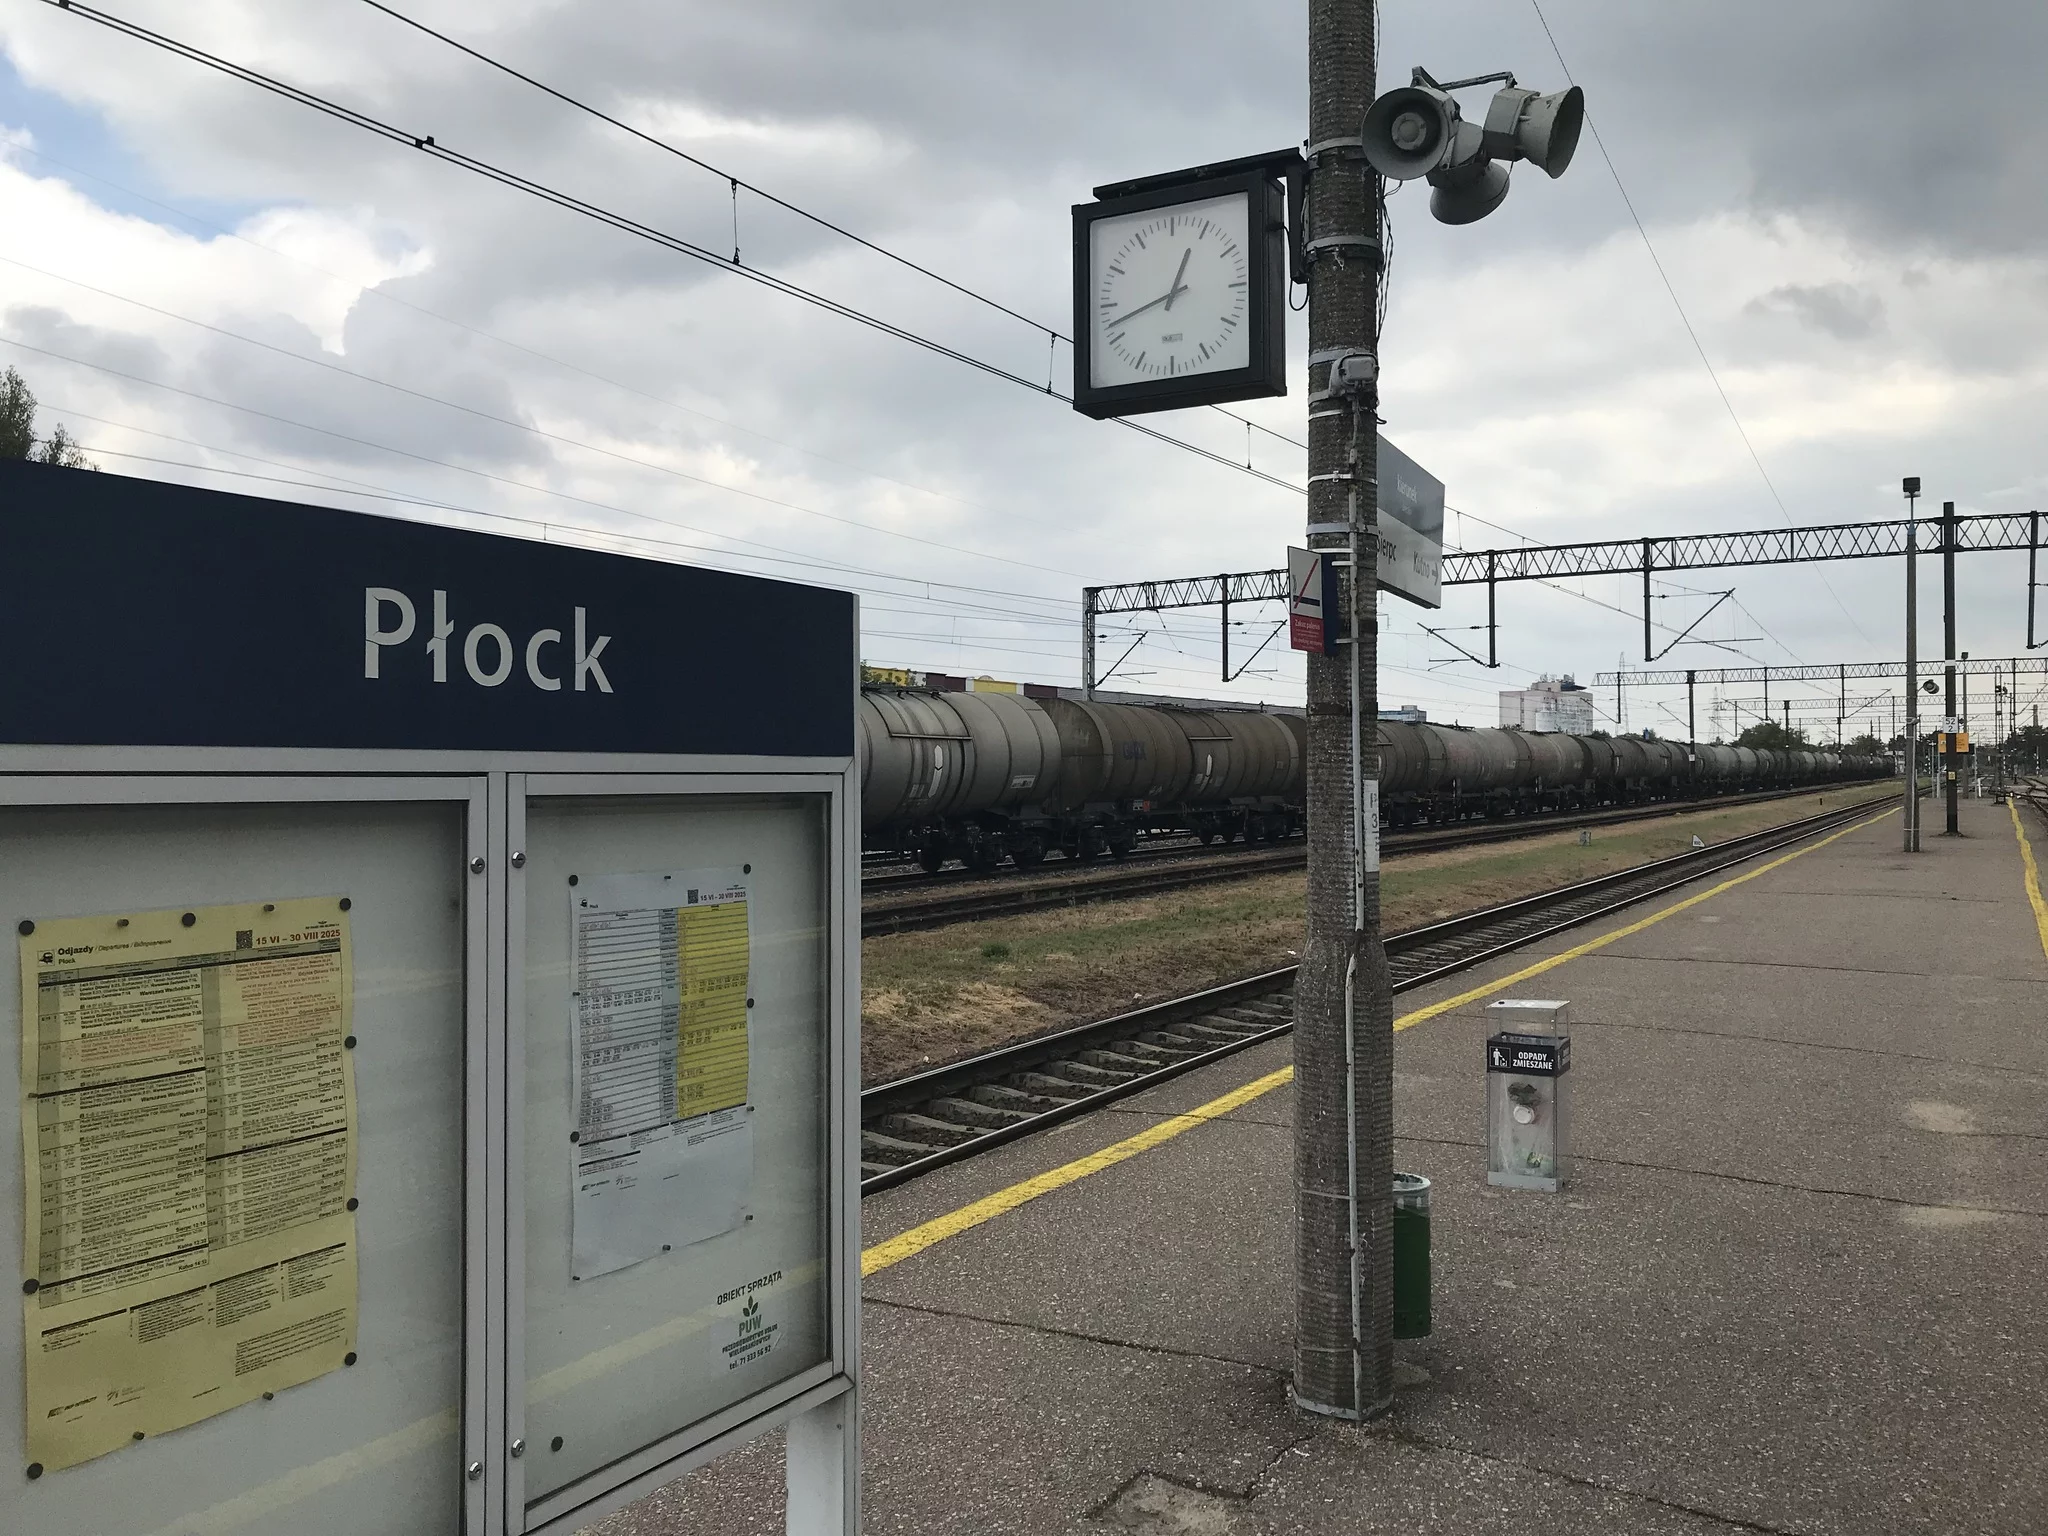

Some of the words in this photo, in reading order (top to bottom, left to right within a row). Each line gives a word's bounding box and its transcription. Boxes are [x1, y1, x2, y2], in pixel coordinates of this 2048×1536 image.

[365, 587, 614, 693] Płock
[1945, 717, 1956, 725] 52
[256, 937, 267, 945] 15
[290, 933, 301, 941] 30
[303, 932, 318, 940] VIII
[320, 930, 340, 939] 2025
[58, 945, 93, 956] Odjazdy
[1518, 1051, 1548, 1061] ODPADY
[1513, 1059, 1553, 1070] ZMIESZANE
[717, 1285, 746, 1305] OBIEKT
[747, 1270, 782, 1293] SPRZĄTA
[739, 1315, 762, 1337] PUW
[747, 1351, 756, 1362] 333
